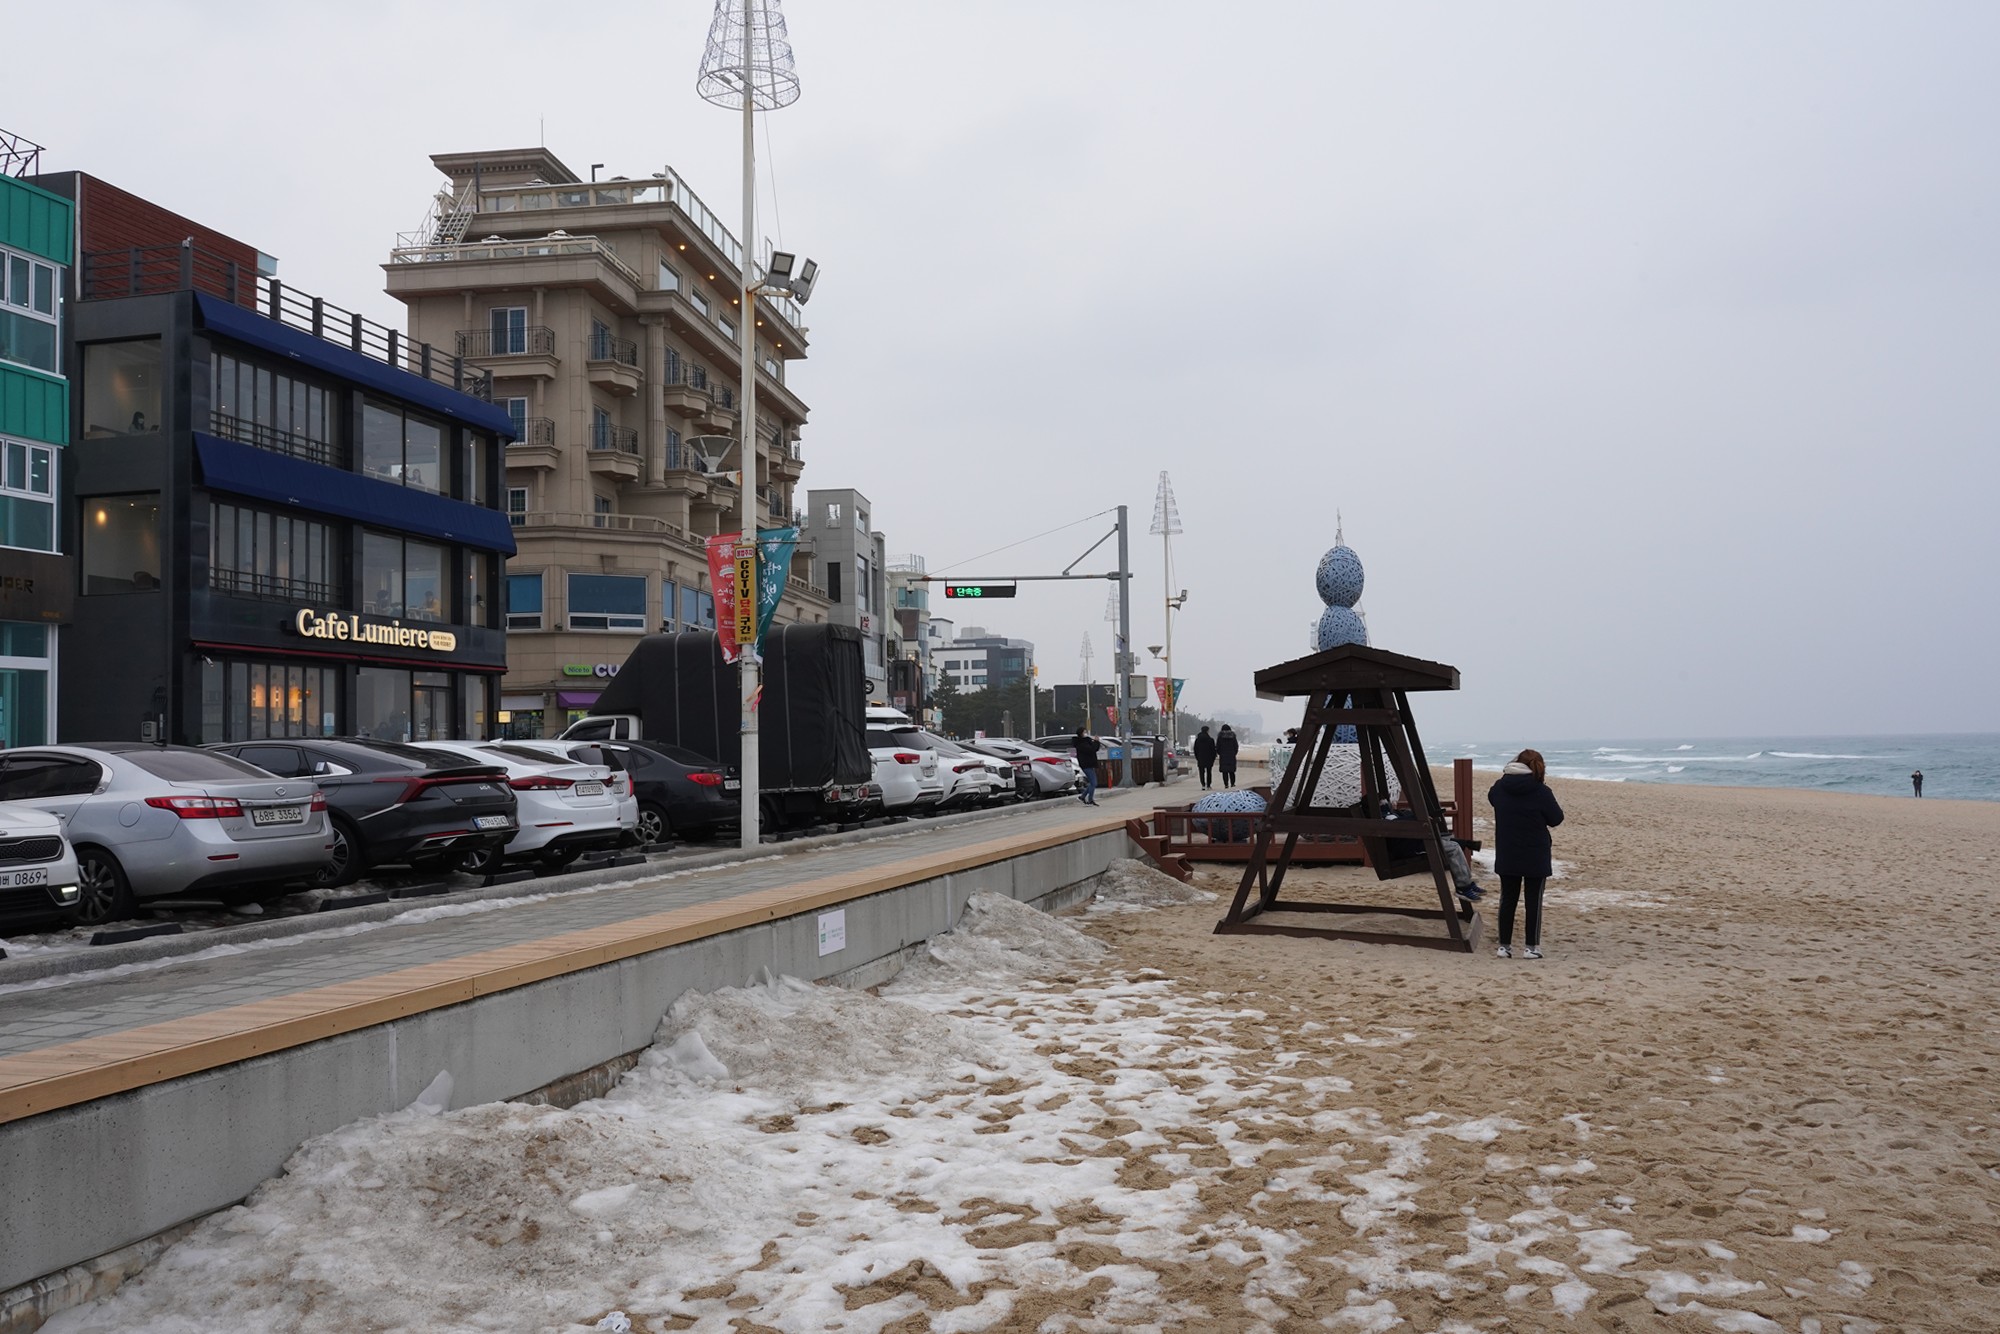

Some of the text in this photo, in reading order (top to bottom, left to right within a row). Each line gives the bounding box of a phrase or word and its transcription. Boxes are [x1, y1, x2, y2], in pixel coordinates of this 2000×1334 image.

[296, 608, 428, 648] Cafe Lumiere
[594, 663, 620, 678] CU
[278, 808, 298, 821] 3356
[15, 871, 42, 886] 0869
